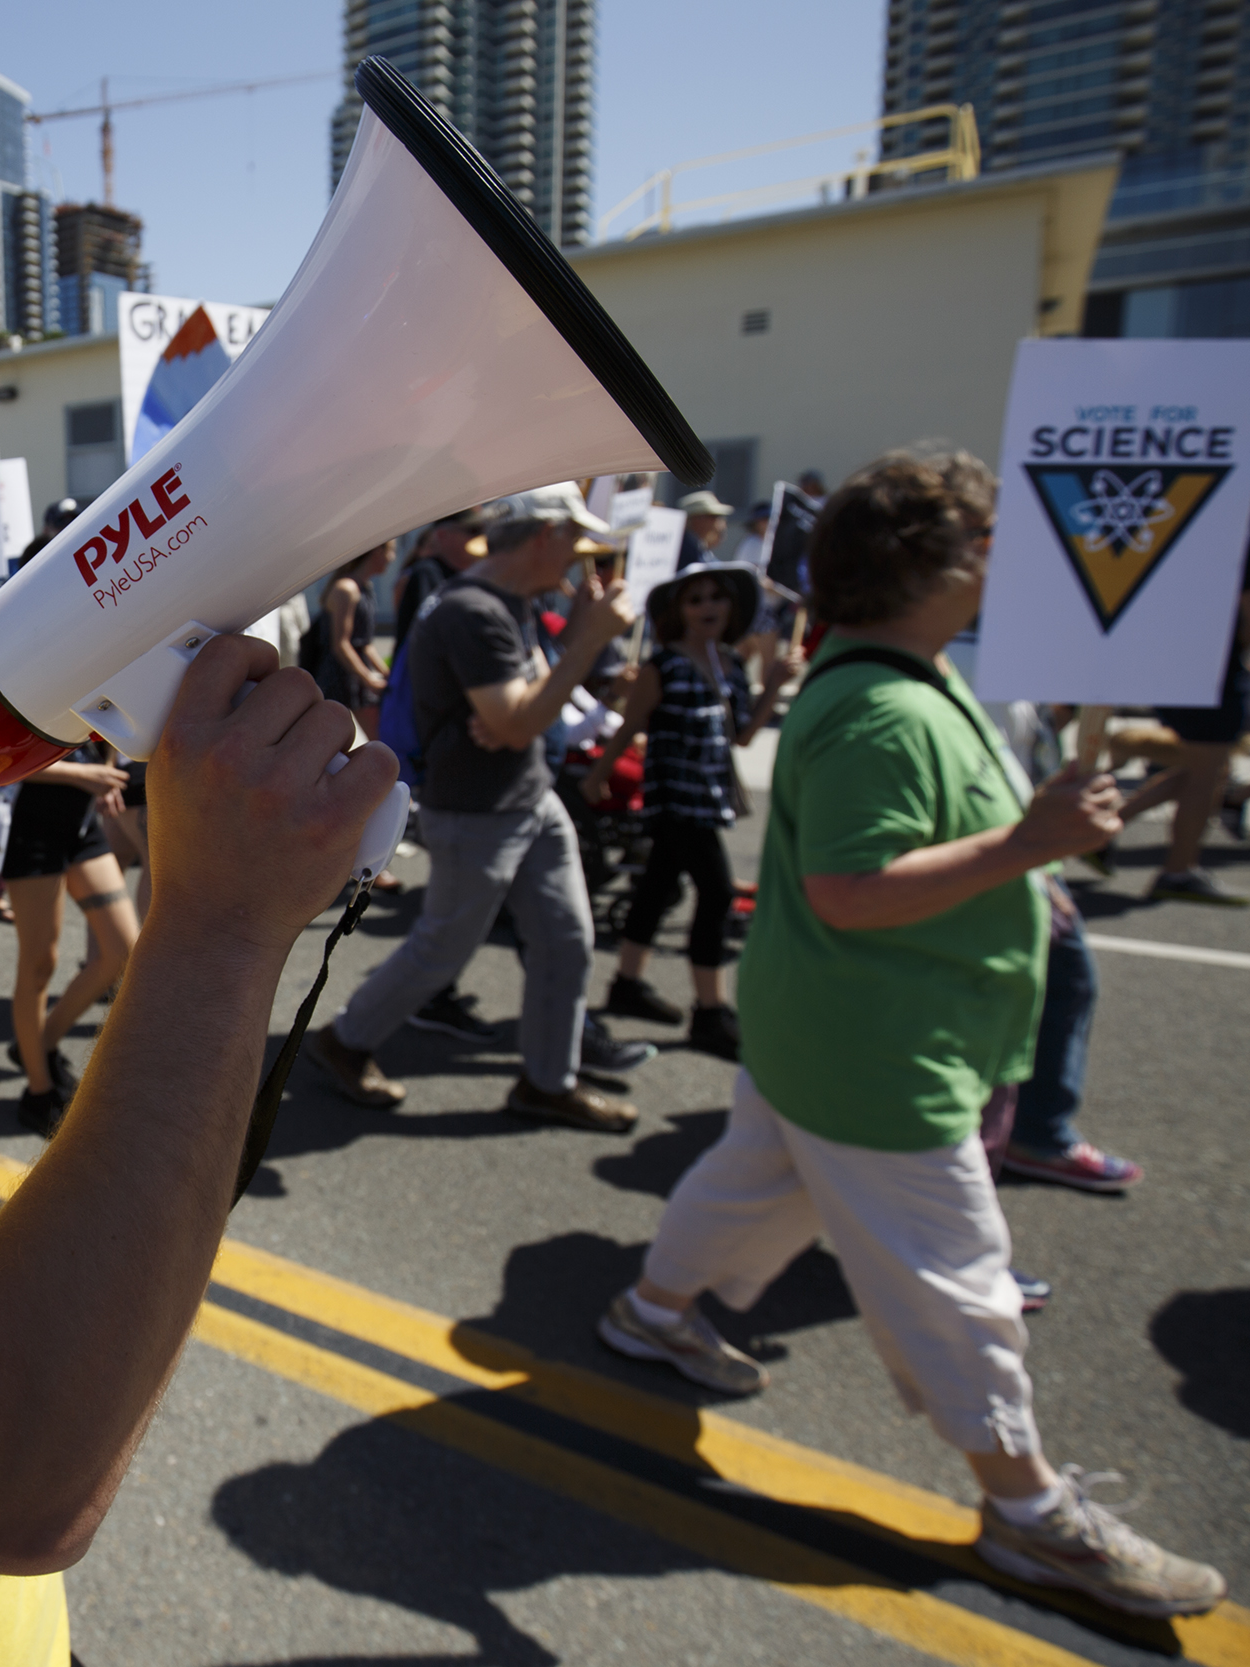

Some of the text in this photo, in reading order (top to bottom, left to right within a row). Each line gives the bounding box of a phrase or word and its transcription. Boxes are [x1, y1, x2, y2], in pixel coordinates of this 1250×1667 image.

[1031, 426, 1236, 458] SCIENCE
[1075, 404, 1199, 422] VOTE FOR
[73, 467, 191, 588] PYLE
[93, 515, 208, 609] PyleUSA.com
